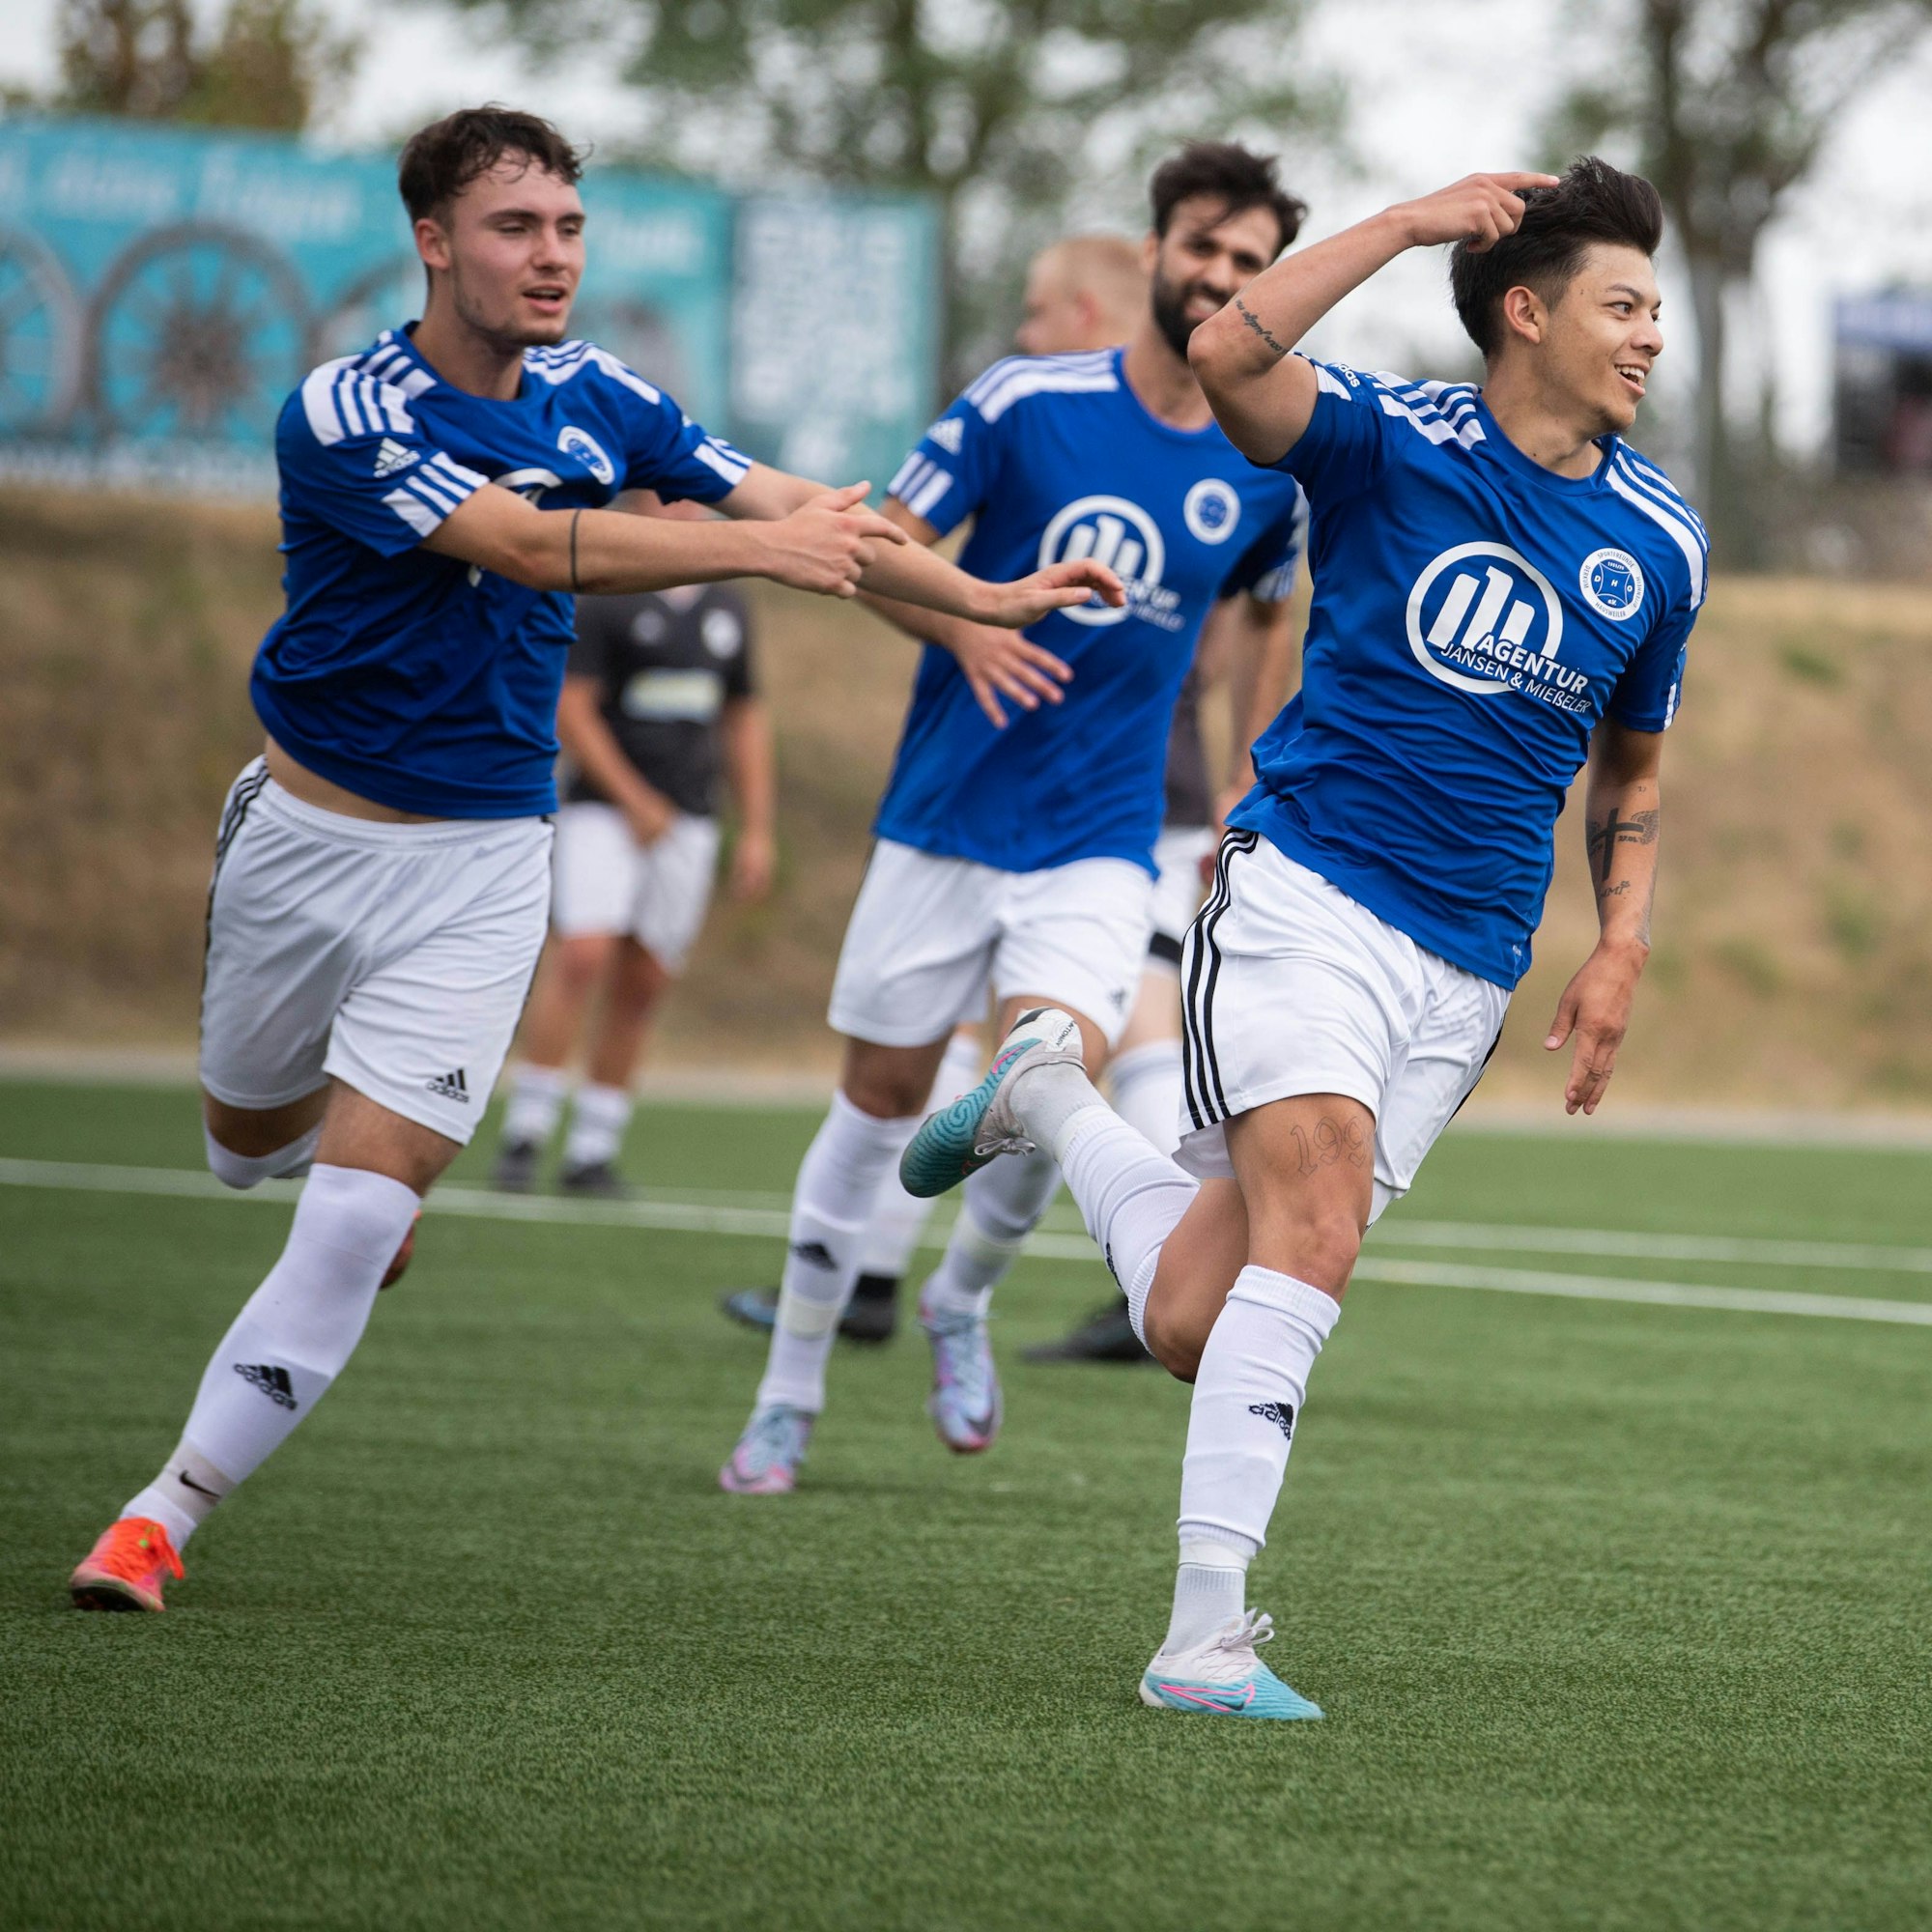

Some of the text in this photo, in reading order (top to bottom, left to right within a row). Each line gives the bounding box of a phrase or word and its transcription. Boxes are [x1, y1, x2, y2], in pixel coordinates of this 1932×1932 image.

[1610, 579, 1619, 587] H
[1440, 642, 1593, 714] JANSEN & MIEßELER
[1477, 634, 1589, 695] AGENTUR
